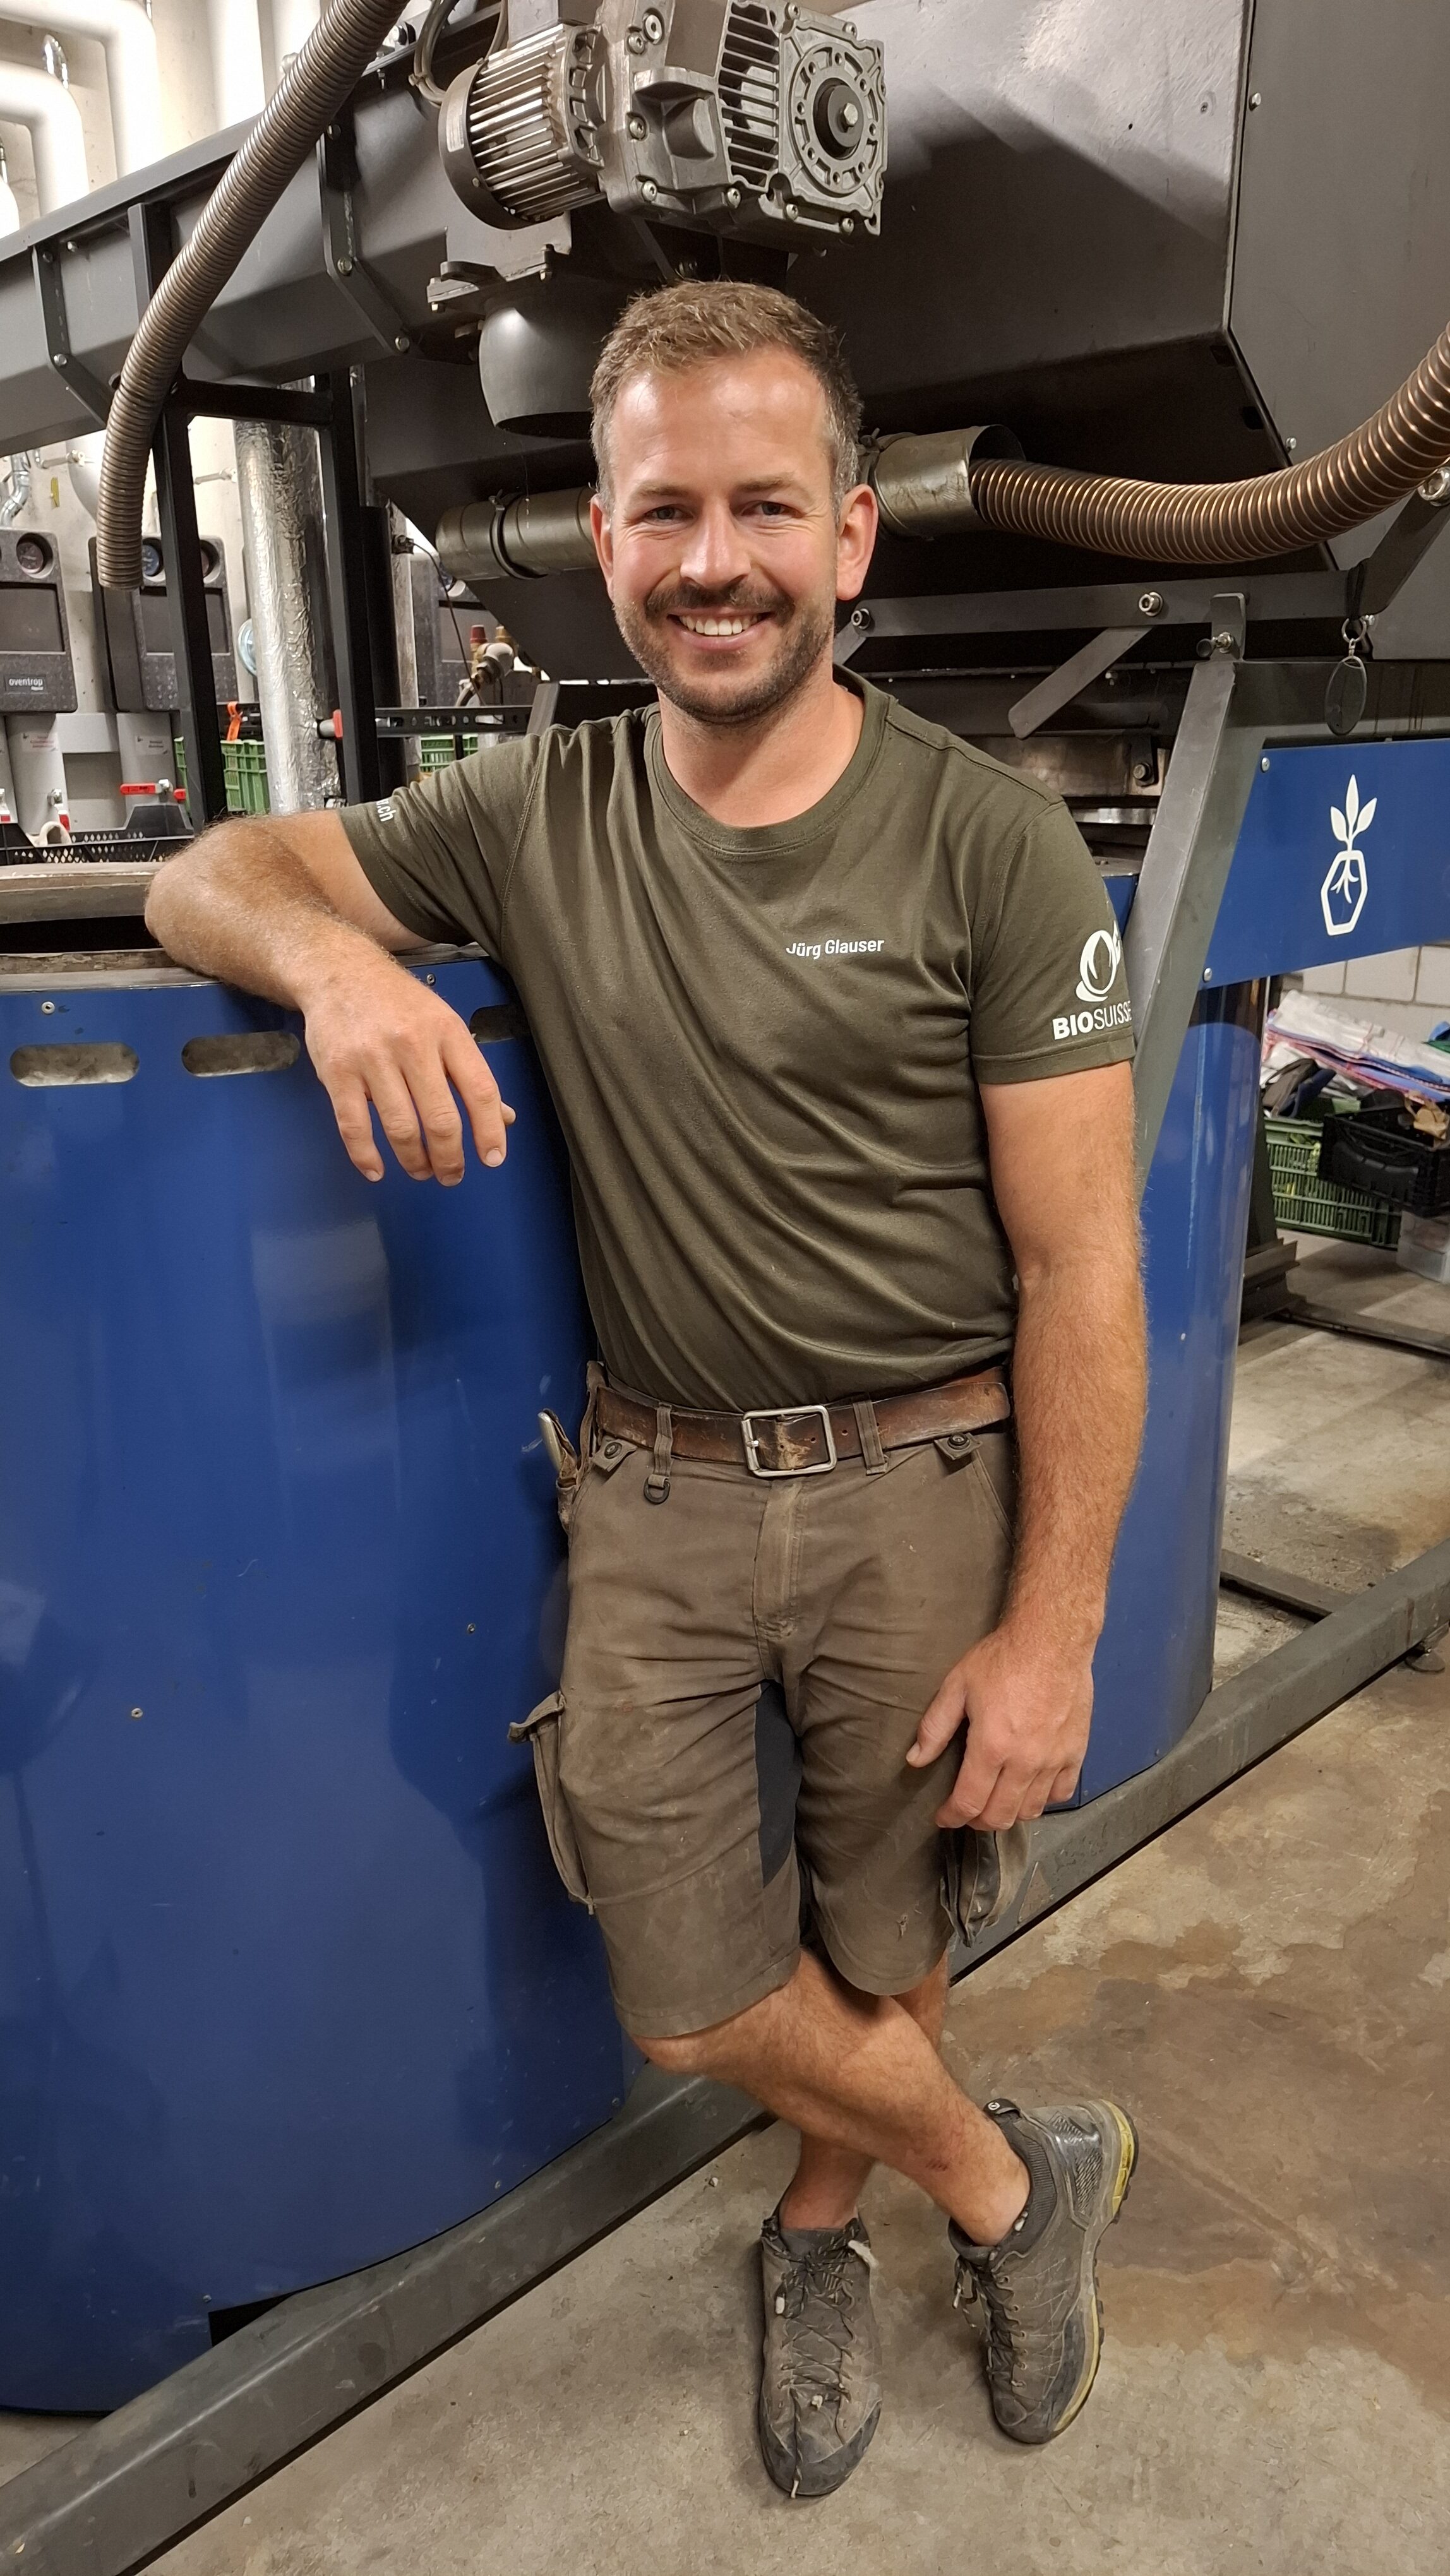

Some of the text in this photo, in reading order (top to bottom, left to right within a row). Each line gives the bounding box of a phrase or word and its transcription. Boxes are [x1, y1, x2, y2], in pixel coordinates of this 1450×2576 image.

[9, 677, 43, 686] oventrop
[786, 939, 885, 960] Jürg Glauser
